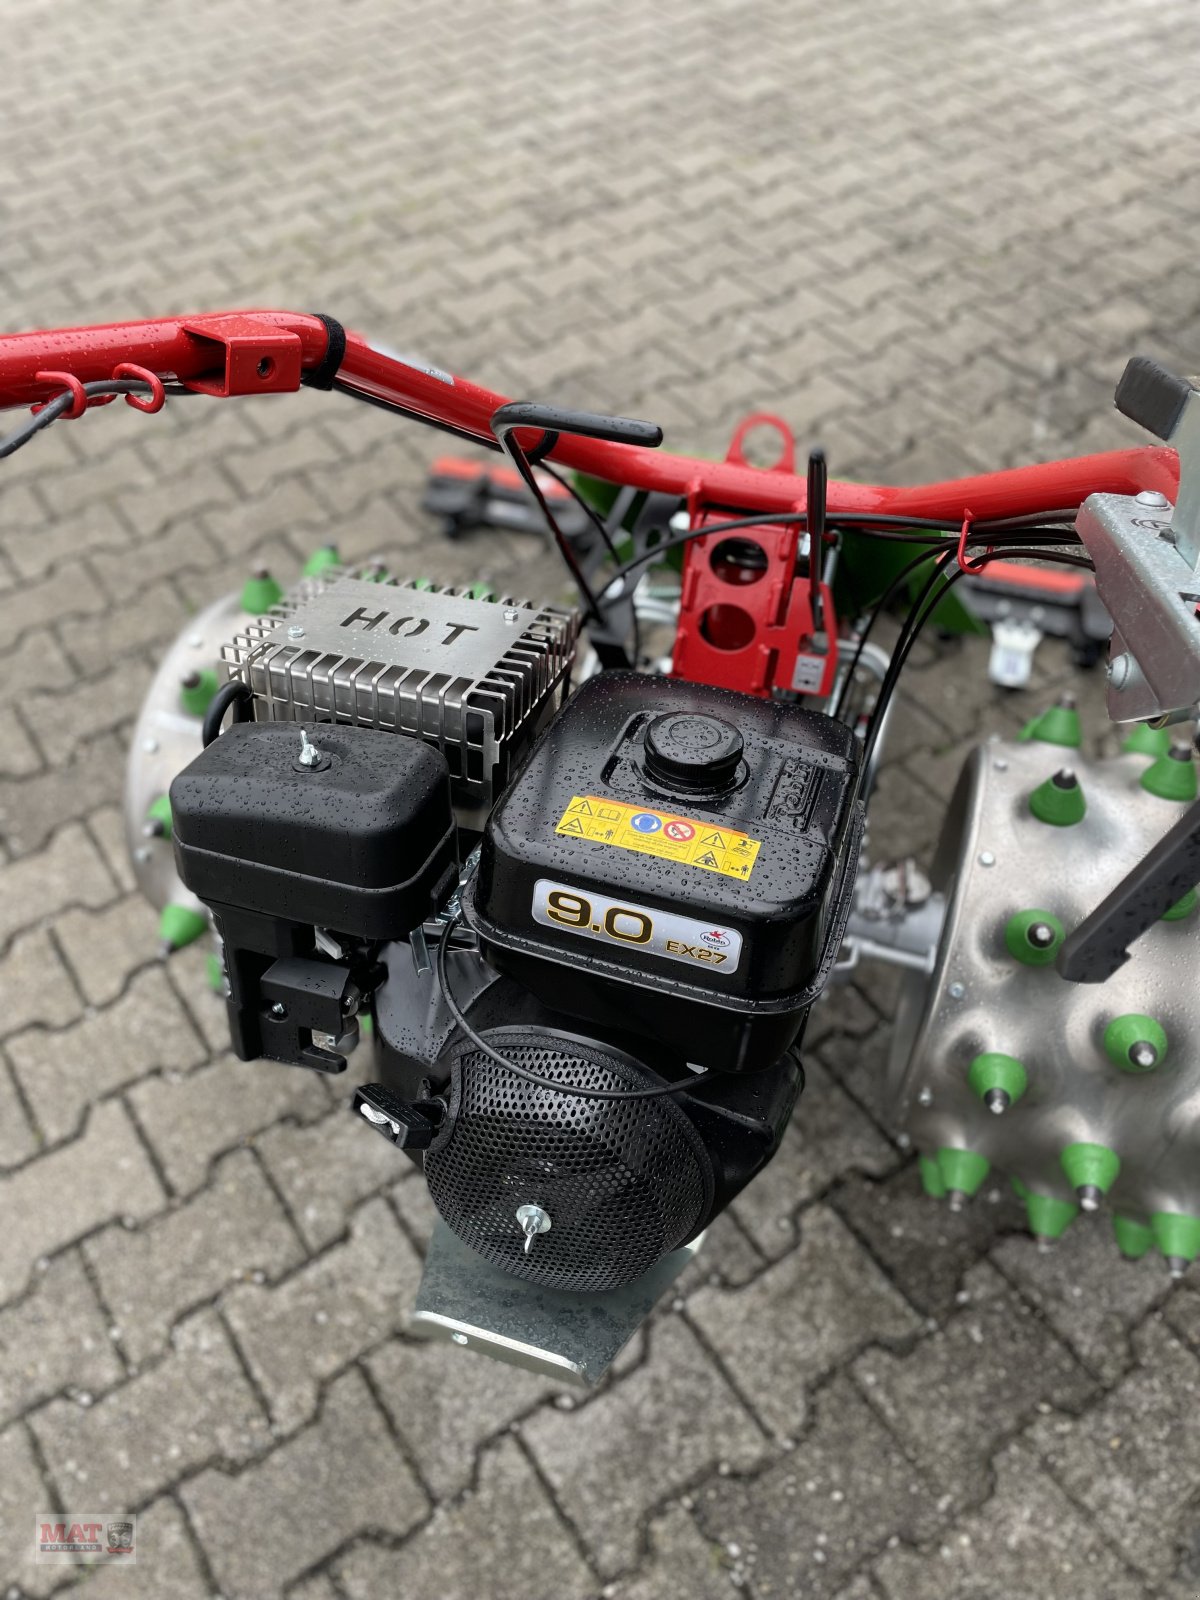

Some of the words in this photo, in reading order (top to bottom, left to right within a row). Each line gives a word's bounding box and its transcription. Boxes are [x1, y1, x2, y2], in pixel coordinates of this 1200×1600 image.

[340, 606, 480, 646] HOT
[546, 891, 654, 944] 9.0
[665, 940, 728, 964] EX27
